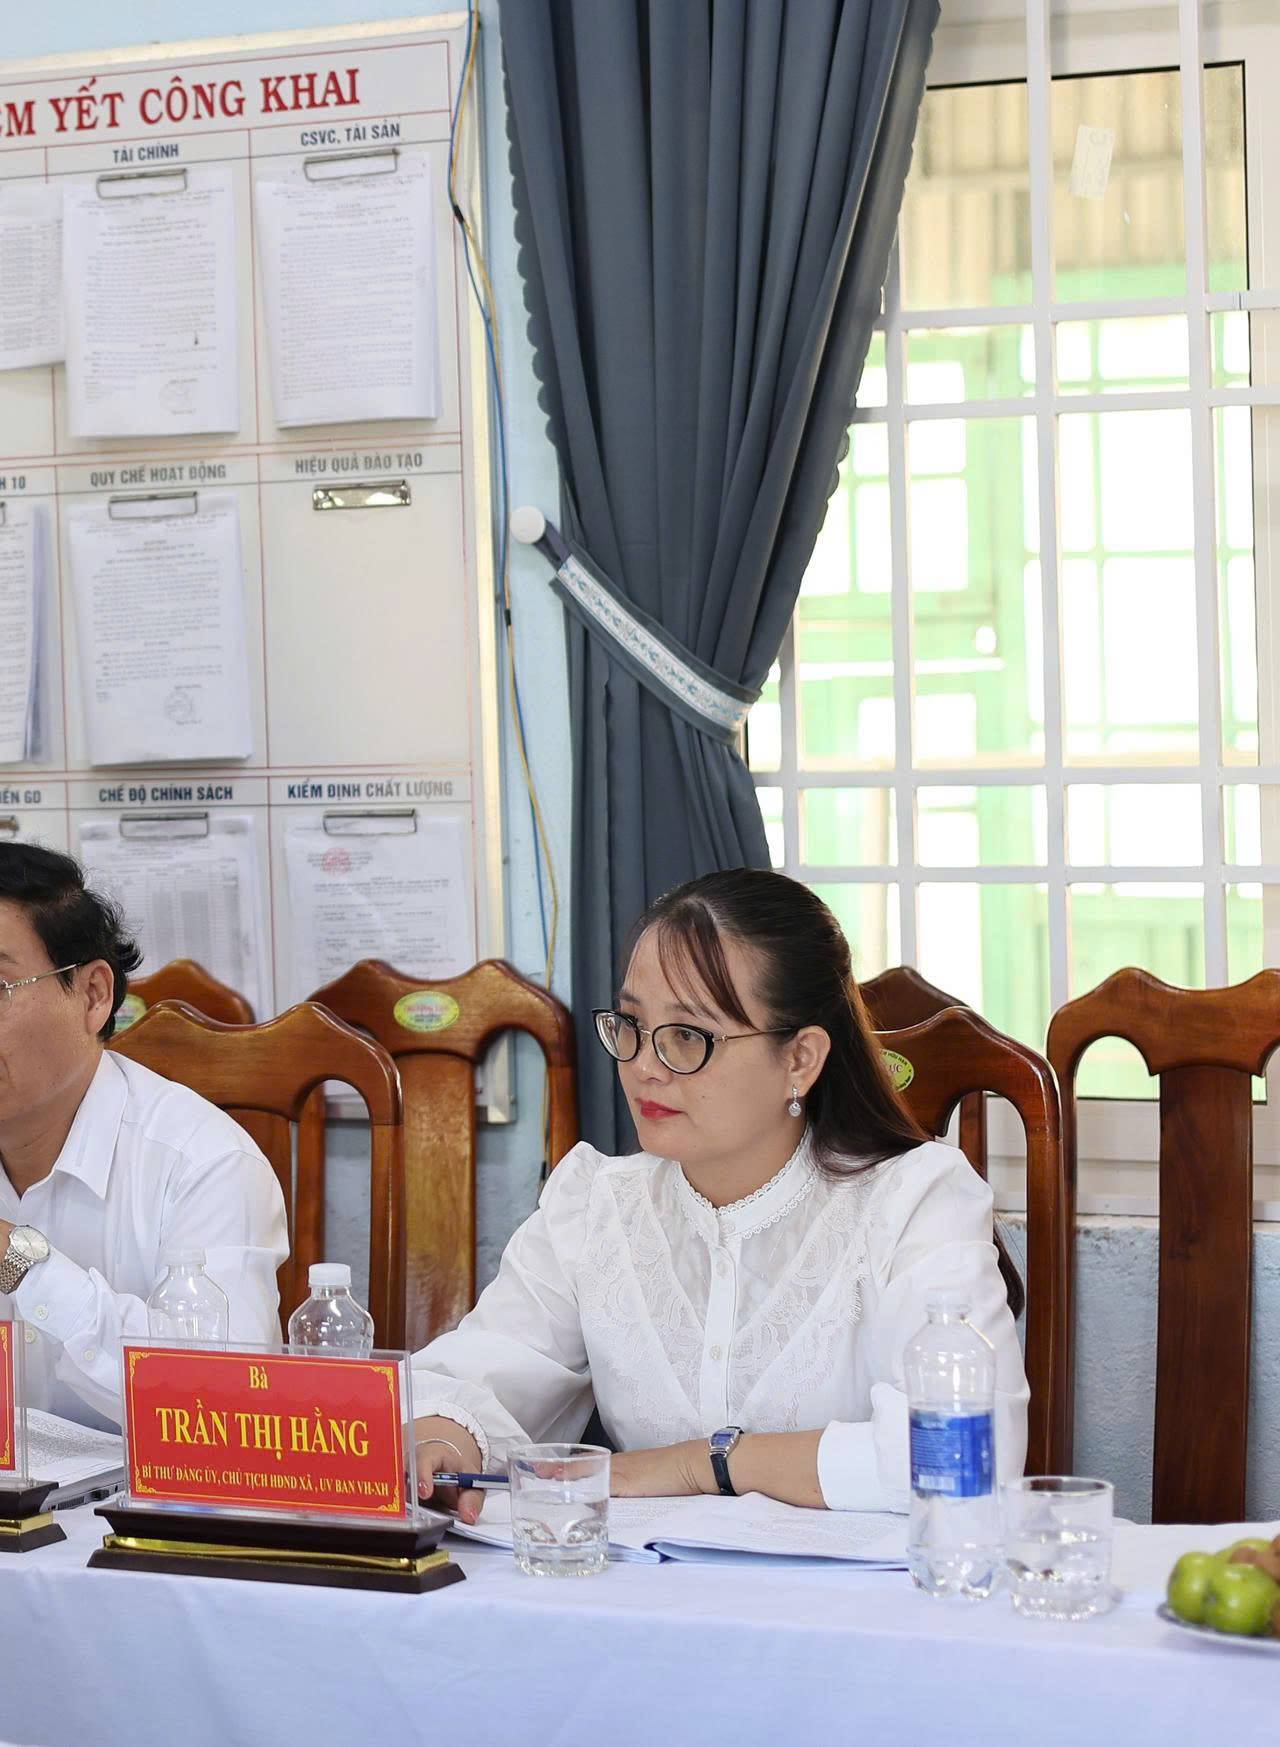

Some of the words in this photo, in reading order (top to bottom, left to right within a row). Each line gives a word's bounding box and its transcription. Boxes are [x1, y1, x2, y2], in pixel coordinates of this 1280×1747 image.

[48, 76, 125, 133] YẾT
[138, 75, 246, 126] CÔNG
[259, 68, 361, 114] KHAI
[345, 124, 367, 142] TÀI
[371, 119, 401, 139] SẢN
[112, 147, 134, 164] TÀI
[137, 142, 180, 162] CHÍNH
[90, 471, 116, 488] QUY
[120, 464, 146, 485] CHẾ
[295, 457, 327, 476] HIỆU
[331, 452, 360, 473] QUẢ
[364, 452, 392, 470] ĐÀO
[396, 452, 424, 472] TẠO
[11, 475, 27, 490] 10
[99, 783, 125, 802] CHẾ
[128, 784, 147, 804] ĐỘ
[151, 783, 193, 800] CHÍNH
[197, 782, 233, 800] SÁCH
[327, 783, 361, 800] ĐỊNH
[365, 778, 401, 798] CHẤT
[406, 781, 453, 799] LƯỢNG
[248, 1365, 269, 1390] Bà
[155, 1398, 228, 1448] TRẦN
[234, 1411, 283, 1461] THỊ
[288, 1406, 369, 1457] HẰNG
[142, 1461, 152, 1478] BÍ
[153, 1464, 175, 1480] THƯ
[222, 1467, 242, 1486] CHỦ
[243, 1471, 268, 1491] TỊCH
[270, 1474, 297, 1489] HĐND
[319, 1478, 333, 1492] UV
[335, 1479, 355, 1494] BAN
[356, 1481, 389, 1497] VH-XH
